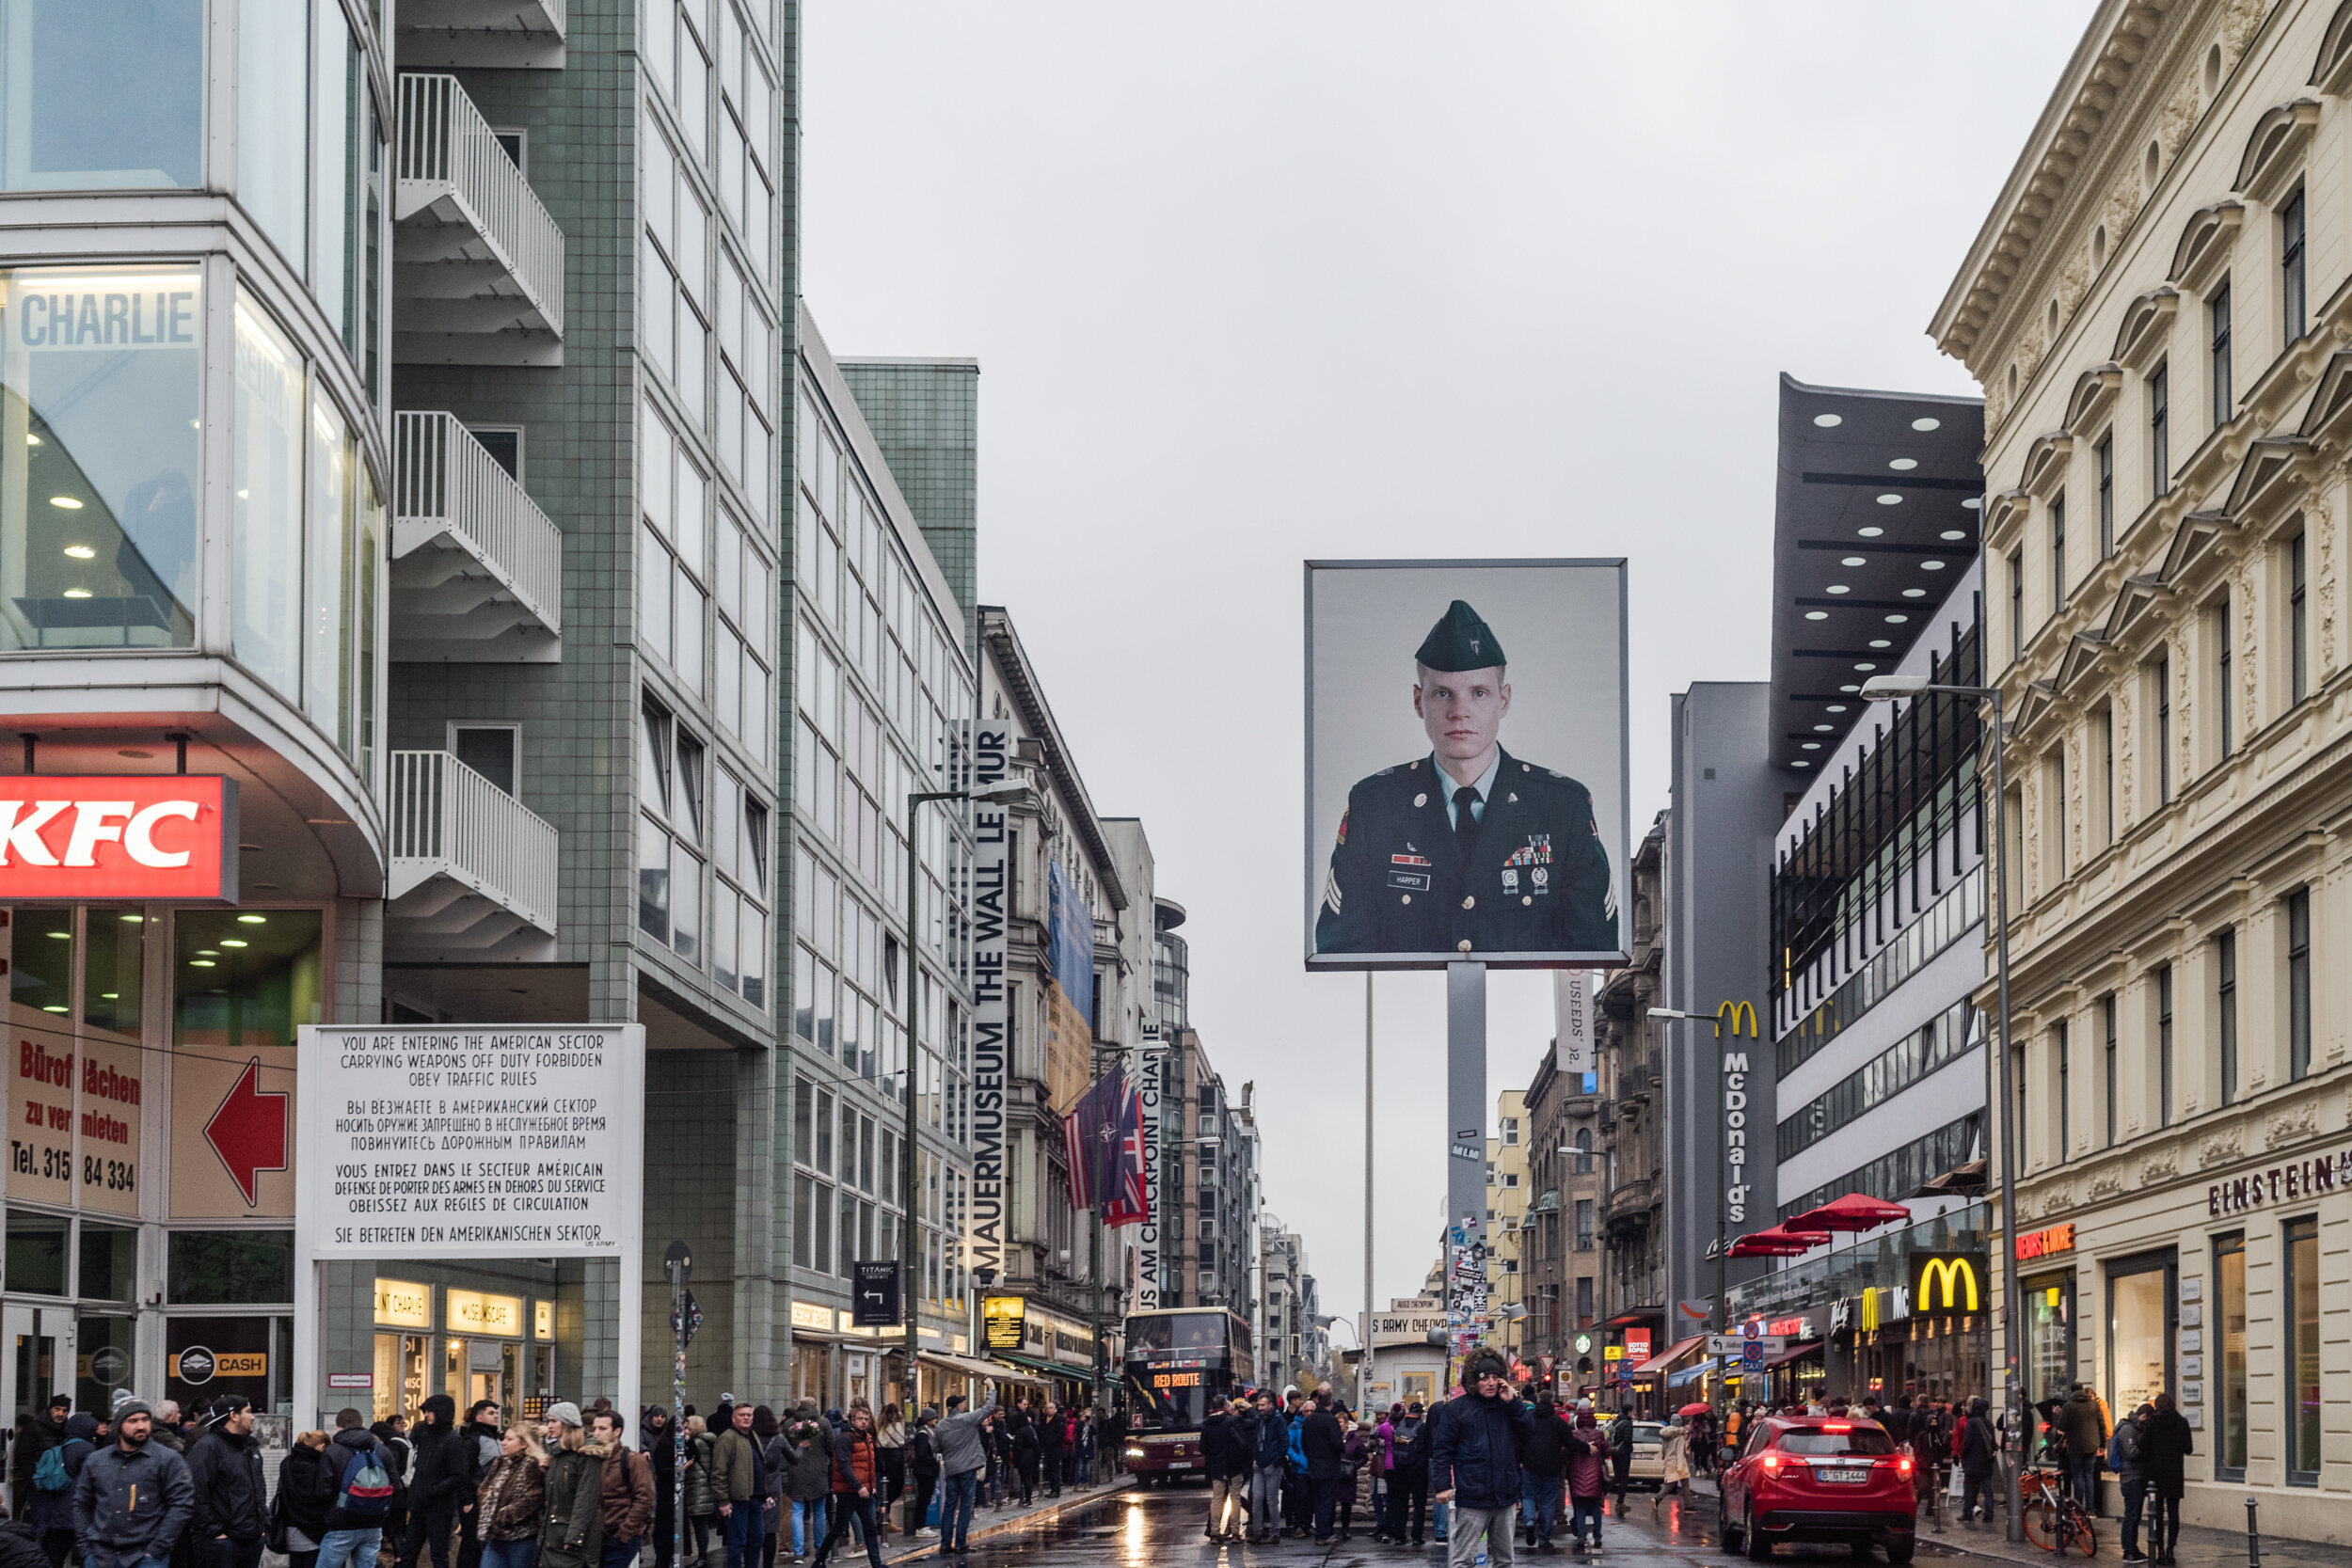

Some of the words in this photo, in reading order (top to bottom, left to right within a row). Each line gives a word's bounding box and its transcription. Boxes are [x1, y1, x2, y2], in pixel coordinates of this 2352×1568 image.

[22, 293, 193, 346] CHARLIE
[0, 800, 199, 867] KFC
[977, 813, 1004, 843] LE
[1396, 875, 1421, 886] HARPER
[976, 859, 1005, 942] WALL
[975, 951, 1003, 1006] THE
[342, 1037, 366, 1051] YOU
[373, 1036, 395, 1050] ARE
[402, 1036, 458, 1050] ENTERING
[465, 1036, 484, 1050] THE
[491, 1035, 551, 1050] AMERICAN
[558, 1035, 604, 1050] SECTOR
[341, 1054, 403, 1069] CARRYING
[407, 1053, 467, 1069] WEAPONS
[472, 1053, 494, 1068] OFF
[501, 1053, 531, 1068] DUTY
[536, 1053, 602, 1067] FORBIDDEN
[1142, 1024, 1159, 1107] CHARIE
[409, 1072, 440, 1086] OBEY
[447, 1071, 495, 1086] TRAFFIC
[501, 1071, 537, 1085] RULES
[347, 1101, 365, 1115] ВЫ
[439, 1101, 446, 1114] В
[453, 1098, 548, 1114] АМЕРИКАНСКИЙ
[554, 1099, 596, 1113] СЕКТОР
[25, 1101, 43, 1127] zu
[48, 1105, 128, 1145] vermieten
[336, 1118, 374, 1132] НОСИТЬ
[377, 1118, 419, 1132] ОРУЖИЕ
[485, 1117, 492, 1131] В
[496, 1117, 568, 1132] НЕСЛУЖЕБНОЕ
[573, 1117, 606, 1131] ВРЕМЯ
[441, 1135, 513, 1150] ДОРОЖНЫМ
[519, 1135, 586, 1149] ПРАВИЛАМ
[1724, 1053, 1750, 1223] McDonald's
[973, 1022, 1004, 1275] MAUERMUSEUM
[11, 1140, 39, 1176] Tel.
[43, 1147, 71, 1180] 315
[84, 1155, 102, 1186] 84
[108, 1159, 134, 1192] 334
[336, 1164, 367, 1179] VOUS
[375, 1164, 417, 1178] ENTREZ
[423, 1163, 455, 1177] DANS
[461, 1163, 472, 1177] LE
[479, 1163, 530, 1177] SECTEUR
[537, 1159, 603, 1177] AMÉRICAIN
[335, 1181, 376, 1195] DEFENSE
[379, 1181, 391, 1195] DE
[393, 1180, 429, 1195] PORTER
[432, 1180, 451, 1194] DES
[453, 1180, 485, 1194] ARMES
[488, 1180, 501, 1194] EN
[505, 1180, 544, 1194] DEHORS
[548, 1180, 562, 1193] DU
[564, 1179, 606, 1193] SERVICE
[1141, 1114, 1158, 1243] CHECKPOINT
[2209, 1155, 2334, 1216] EINSTEIN
[349, 1198, 407, 1212] OBEISSEZ
[414, 1198, 438, 1212] AUX
[444, 1197, 486, 1212] REGLES
[493, 1197, 506, 1211] DE
[514, 1197, 588, 1211] CIRCULATION
[335, 1227, 353, 1243] SIE
[359, 1227, 415, 1243] BETRETEN
[421, 1227, 444, 1242] DEN
[450, 1226, 551, 1242] AMERIKANISCHEN
[557, 1225, 601, 1241] SEKTOR
[1140, 1250, 1157, 1283] AM
[392, 1294, 422, 1316] CHARLIE
[1383, 1319, 1408, 1332] ARMY
[219, 1358, 262, 1371] CASH
[1153, 1374, 1170, 1388] RED
[1172, 1372, 1200, 1387] ROUTE
[1135, 1417, 1140, 1425] 4
[1822, 1470, 1828, 1479] B
[1846, 1471, 1866, 1480] 1444
